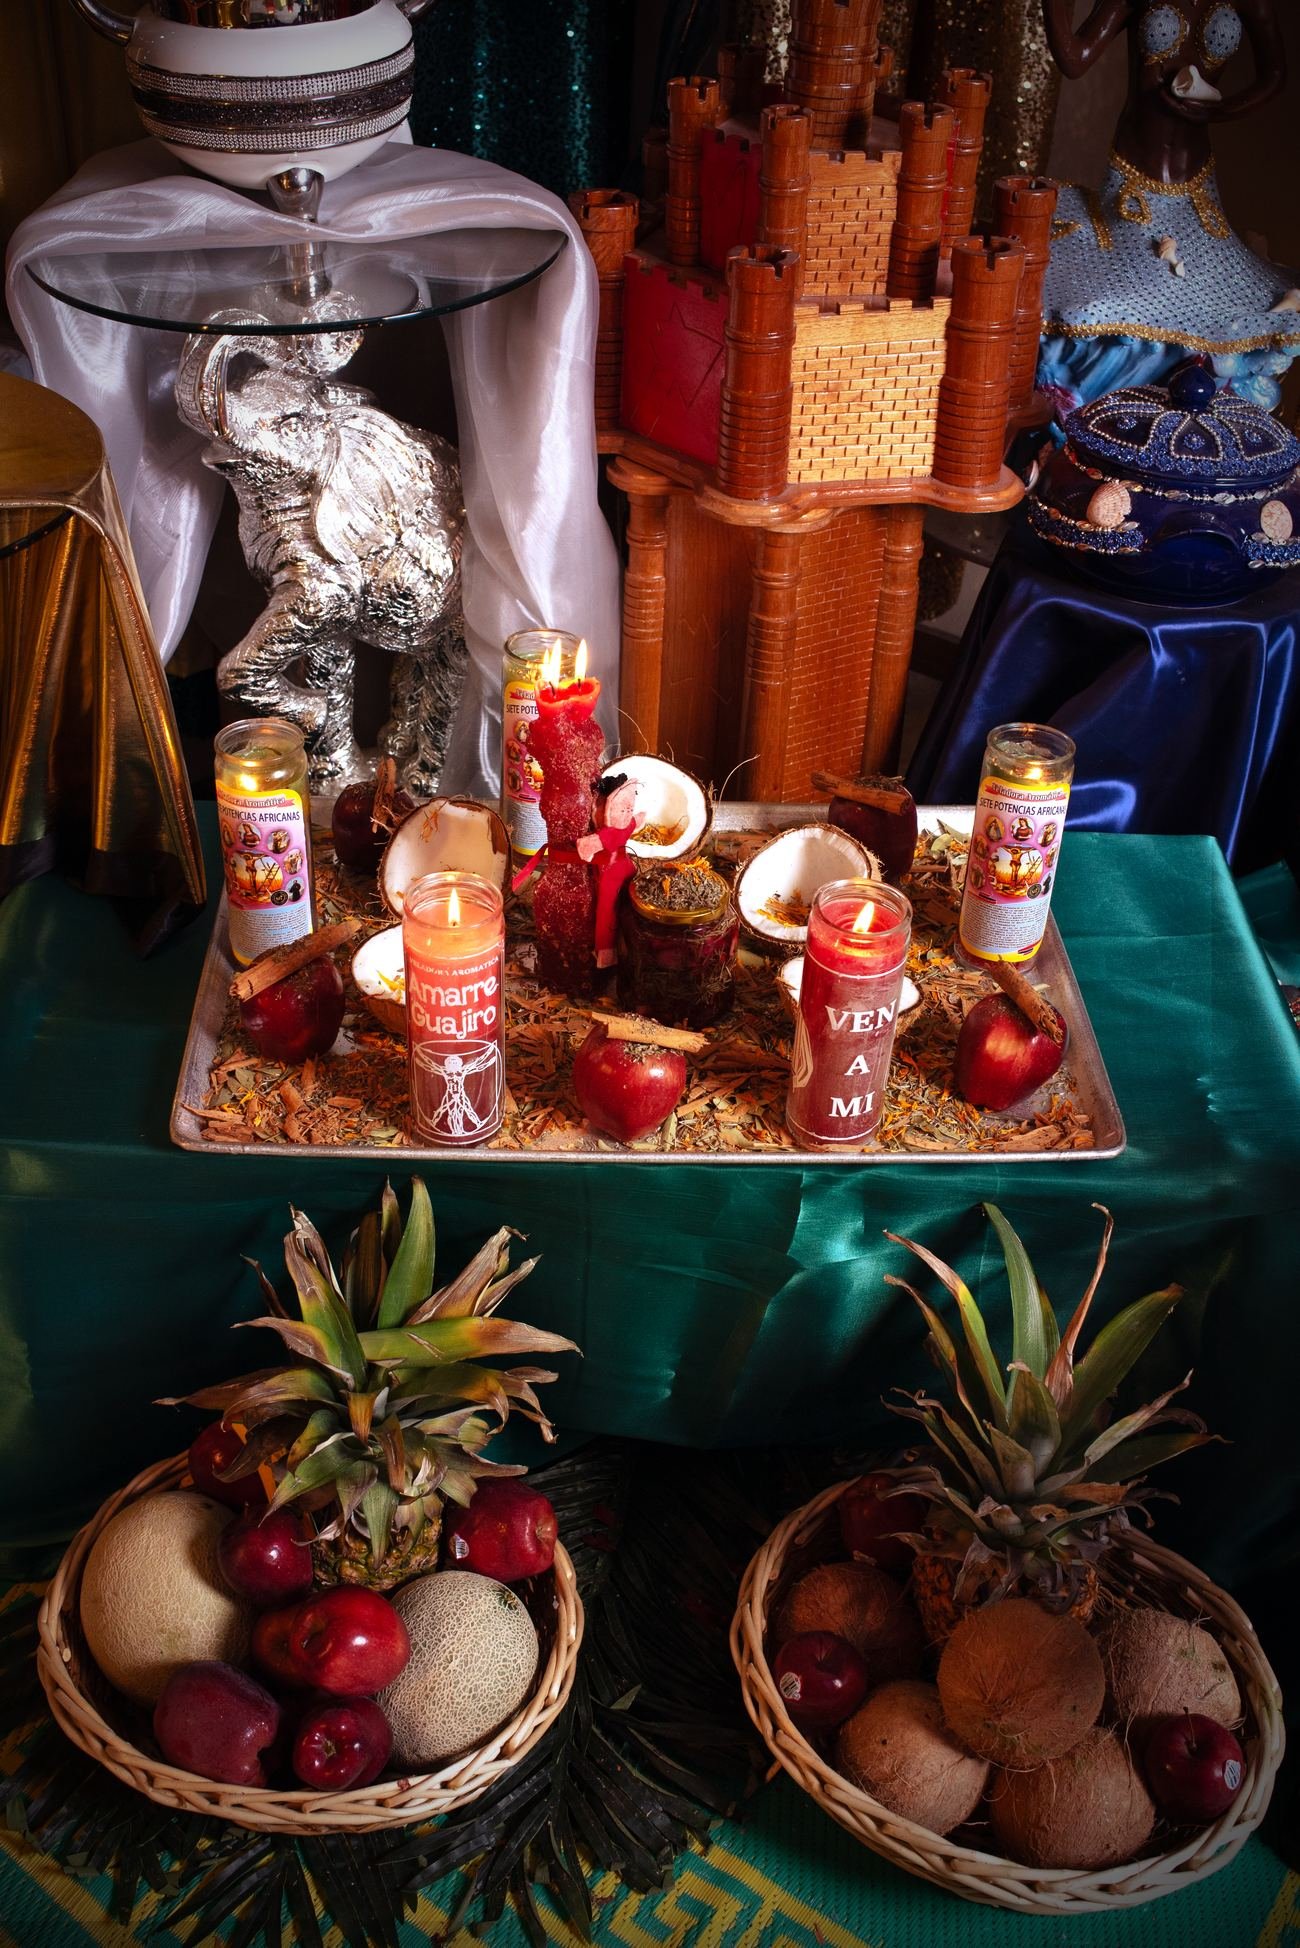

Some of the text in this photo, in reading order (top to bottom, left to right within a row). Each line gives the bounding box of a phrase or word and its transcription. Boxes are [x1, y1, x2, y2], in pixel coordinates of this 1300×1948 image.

[506, 704, 539, 714] SIETE POTE
[258, 811, 301, 823] AFRICANAS
[993, 801, 1036, 816] POTENCIAS
[1036, 805, 1066, 816] AFRICANA
[451, 955, 499, 976] AROMATICA
[408, 970, 500, 1007] Amarre
[411, 998, 497, 1040] Guajiro
[824, 998, 898, 1033] VEN
[844, 1054, 871, 1076] A
[828, 1090, 876, 1118] MI
